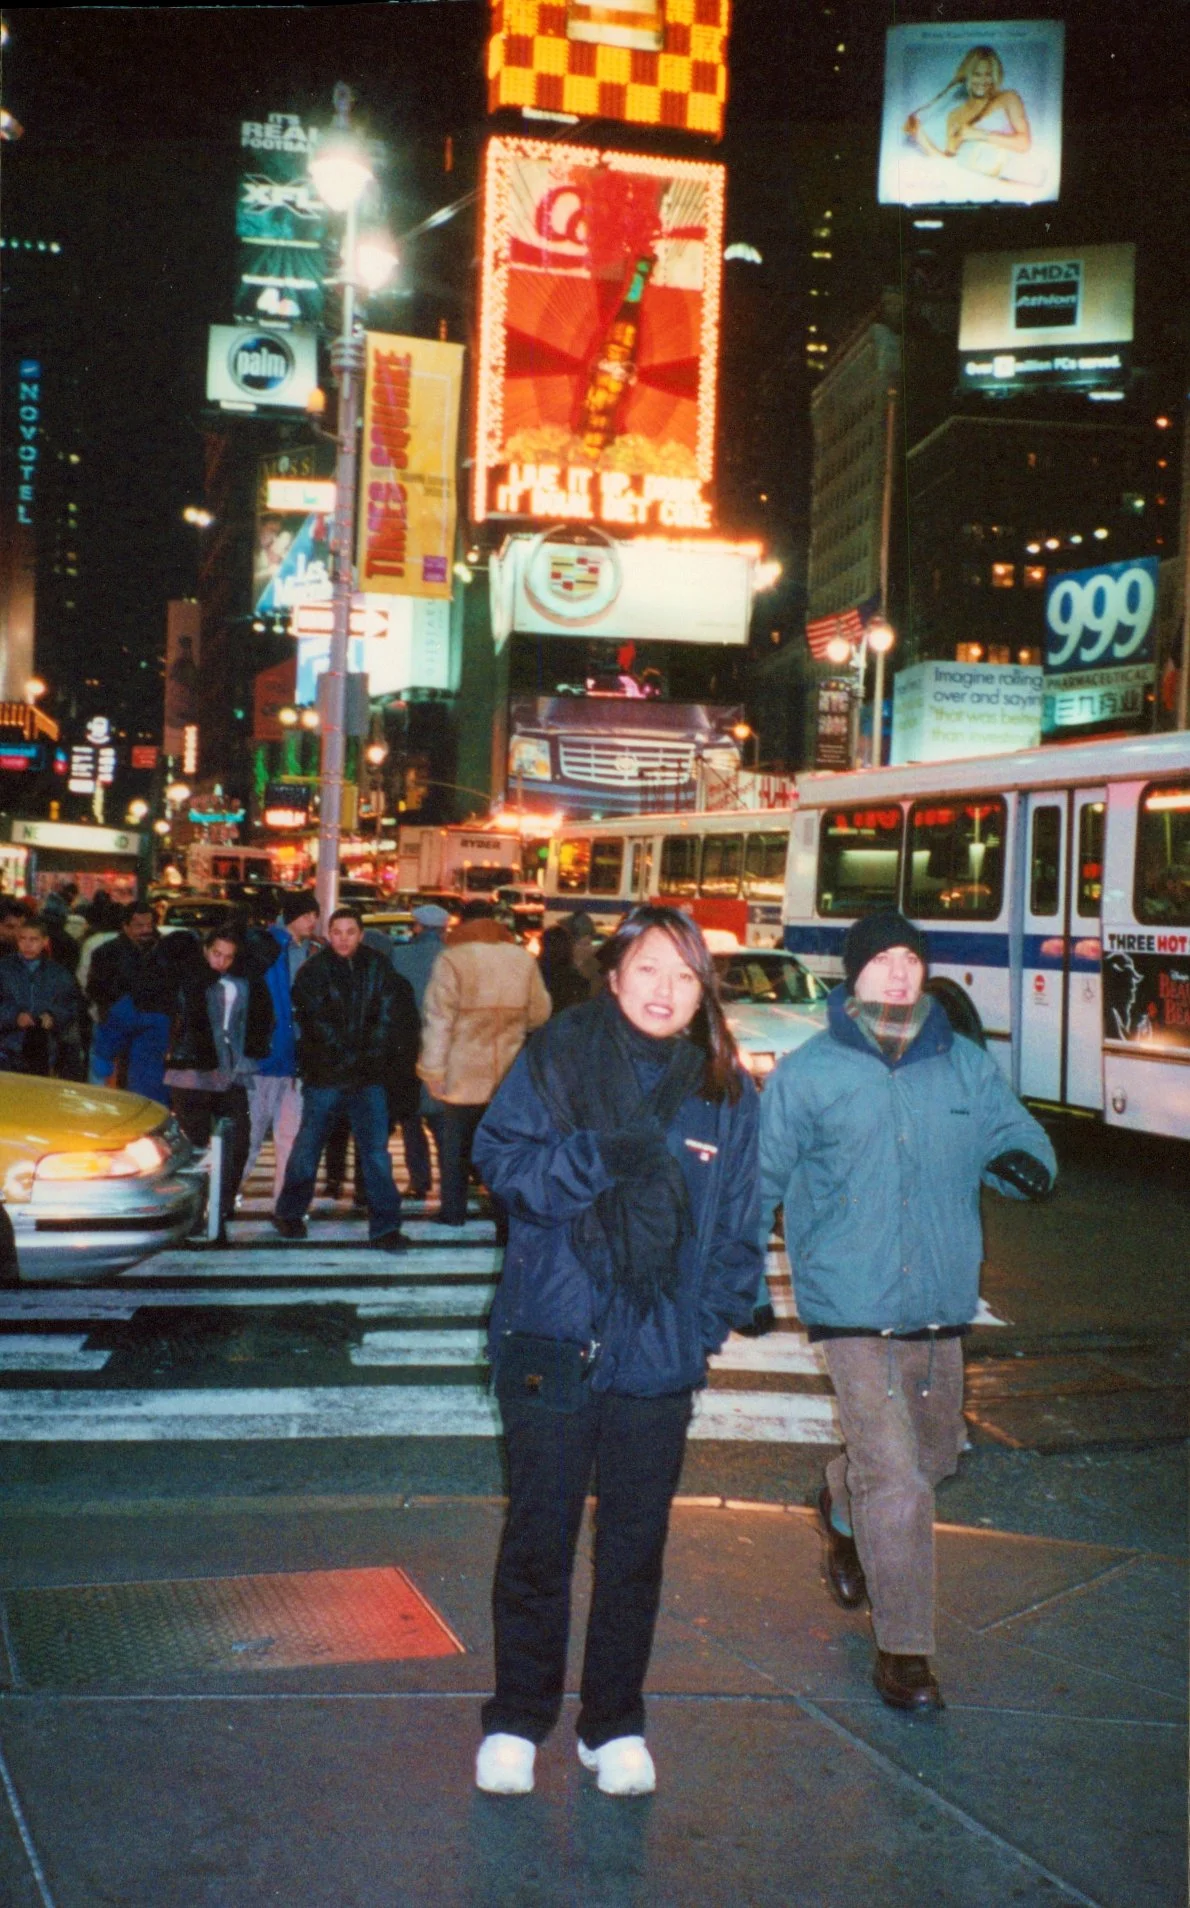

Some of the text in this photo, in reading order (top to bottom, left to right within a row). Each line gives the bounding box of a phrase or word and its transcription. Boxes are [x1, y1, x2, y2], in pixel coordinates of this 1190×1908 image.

[1016, 264, 1064, 282] AMD
[236, 346, 287, 378] palm
[16, 382, 41, 525] NOVOTEL
[364, 348, 412, 579] TIMES SQUARE
[1047, 567, 1155, 666] 999
[934, 667, 1043, 692] Imagine rolling
[933, 691, 967, 704] over
[970, 688, 1000, 705] and
[460, 839, 501, 850] RYDER
[1108, 933, 1187, 952] THREE HOT
